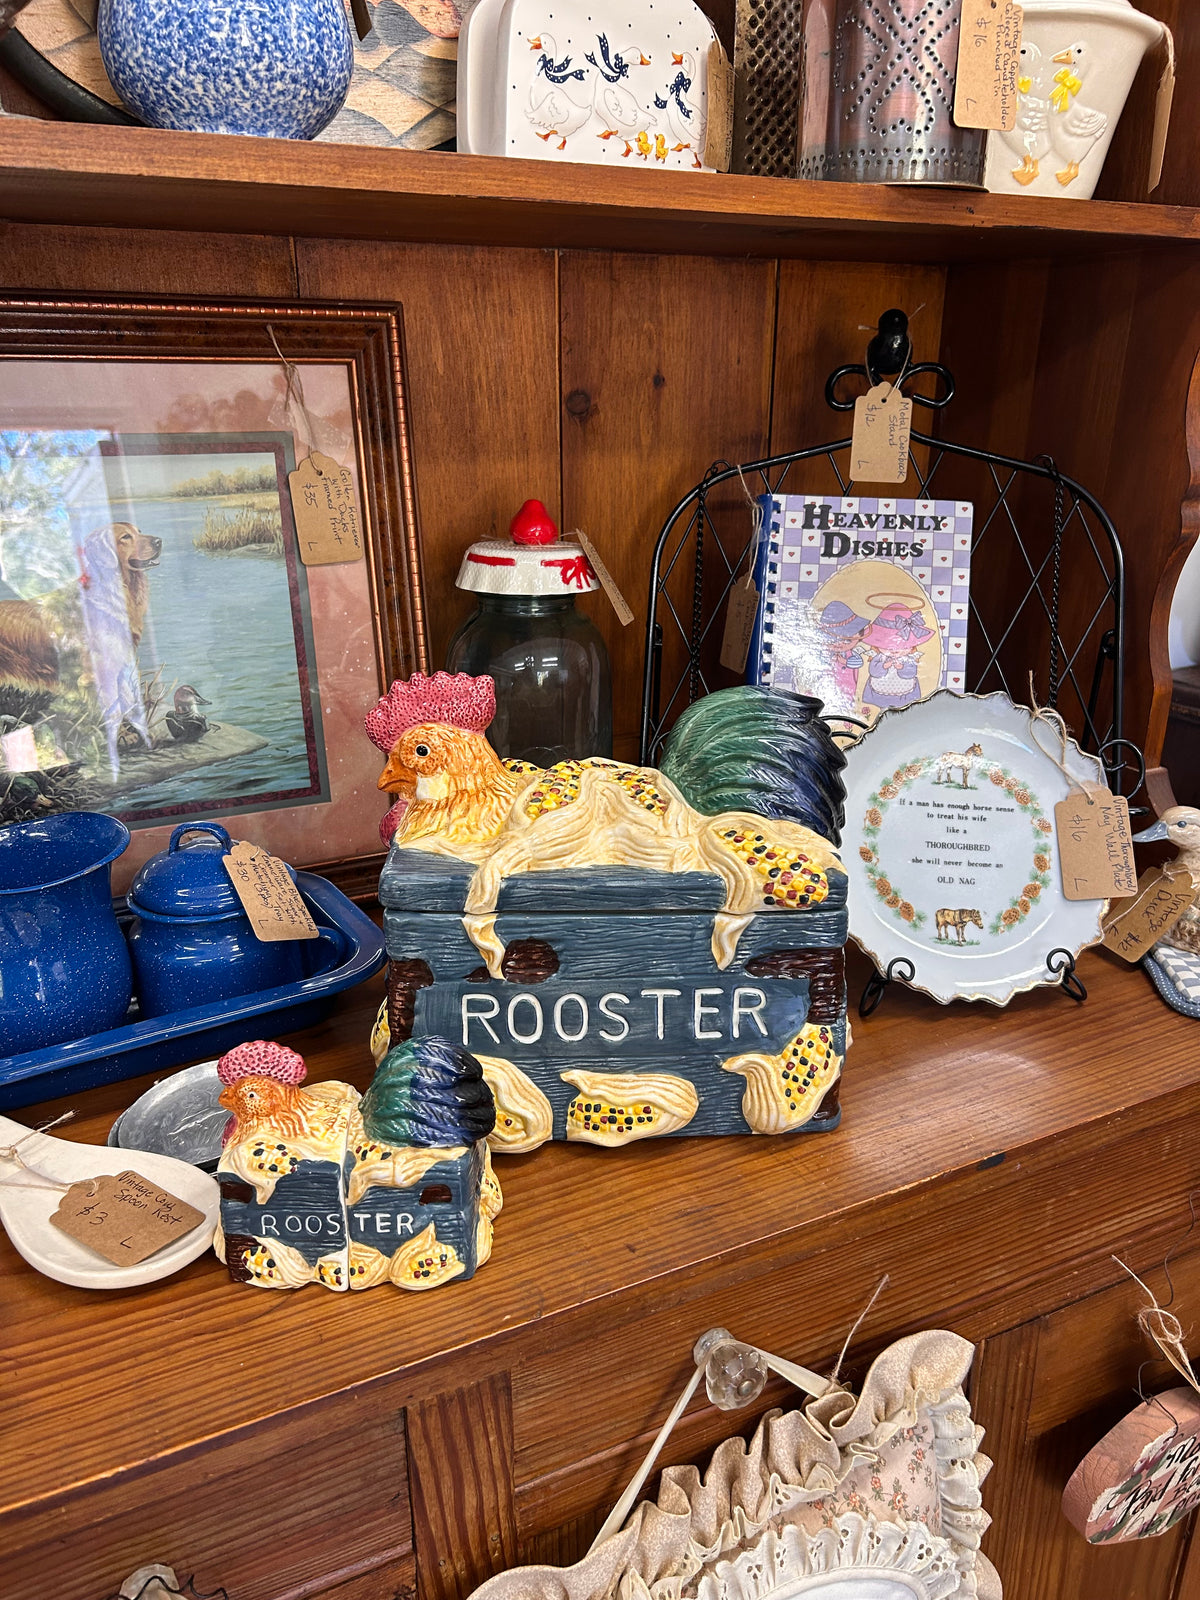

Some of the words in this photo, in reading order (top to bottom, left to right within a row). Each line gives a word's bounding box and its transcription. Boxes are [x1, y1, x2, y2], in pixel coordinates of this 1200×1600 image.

[1009, 10, 1022, 57] Vintage
[1008, 60, 1018, 95] Copper
[864, 402, 882, 428] $12
[898, 401, 910, 430] Metal
[888, 414, 898, 448] Stand
[302, 482, 318, 508] $35
[322, 476, 337, 511] Framed
[330, 516, 342, 545] Print
[340, 469, 352, 501] Golden
[348, 506, 361, 549] Retriever
[308, 541, 318, 552] L
[899, 798, 906, 806] If
[916, 800, 930, 808] man
[932, 800, 944, 808] has
[947, 803, 970, 811] enough
[973, 804, 992, 812] horse
[937, 812, 954, 820] treat
[957, 813, 968, 821] his
[972, 814, 988, 822] wife
[1098, 806, 1114, 828] Nag
[1112, 798, 1128, 838] Vintage
[946, 826, 960, 834] like
[1066, 814, 1091, 842] $16
[924, 840, 991, 852] THOROUGHBRED
[1105, 832, 1120, 862] Wall
[233, 860, 250, 882] $30
[911, 856, 923, 864] she
[967, 860, 992, 868] become
[936, 876, 955, 884] OLD
[958, 876, 976, 886] NAG
[1074, 877, 1088, 892] L
[1112, 864, 1126, 892] Plate
[1142, 888, 1172, 919] Duck
[1149, 893, 1192, 934] Vintage
[258, 919, 268, 930] L
[460, 986, 769, 1046] ROOSTER
[118, 1172, 154, 1198] Vintage
[114, 1188, 148, 1210] Spoon
[152, 1208, 184, 1225] Rest
[120, 1236, 133, 1249] L
